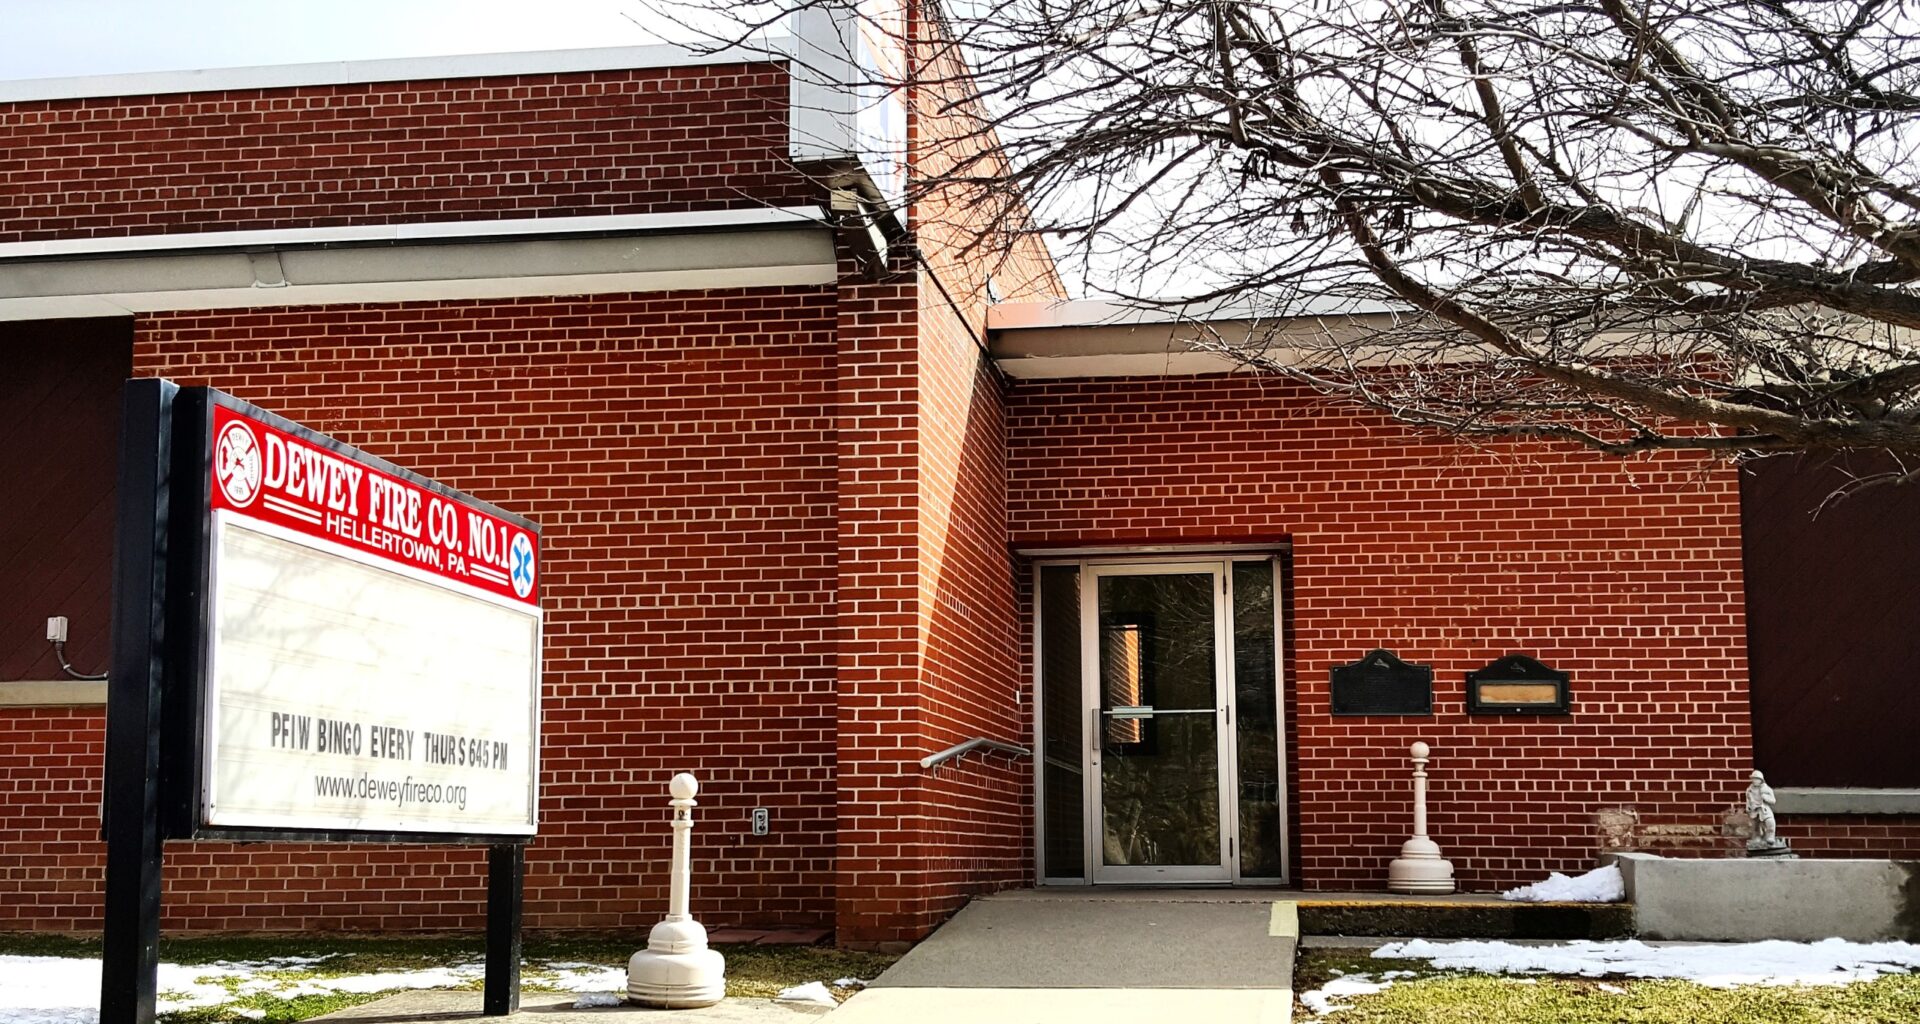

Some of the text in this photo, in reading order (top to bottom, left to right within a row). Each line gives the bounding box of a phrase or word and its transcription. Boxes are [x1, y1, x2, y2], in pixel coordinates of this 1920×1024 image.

[264, 433, 362, 516] DEWEY
[368, 474, 422, 538] FIRE
[428, 498, 463, 552] CO.
[467, 512, 510, 569] NO.1
[326, 512, 470, 577] HELLERTOWN, PA.
[271, 711, 509, 770] PFIW BINGO EVERY THURS 645 PM
[315, 772, 467, 811] www.deweyfireco.org
